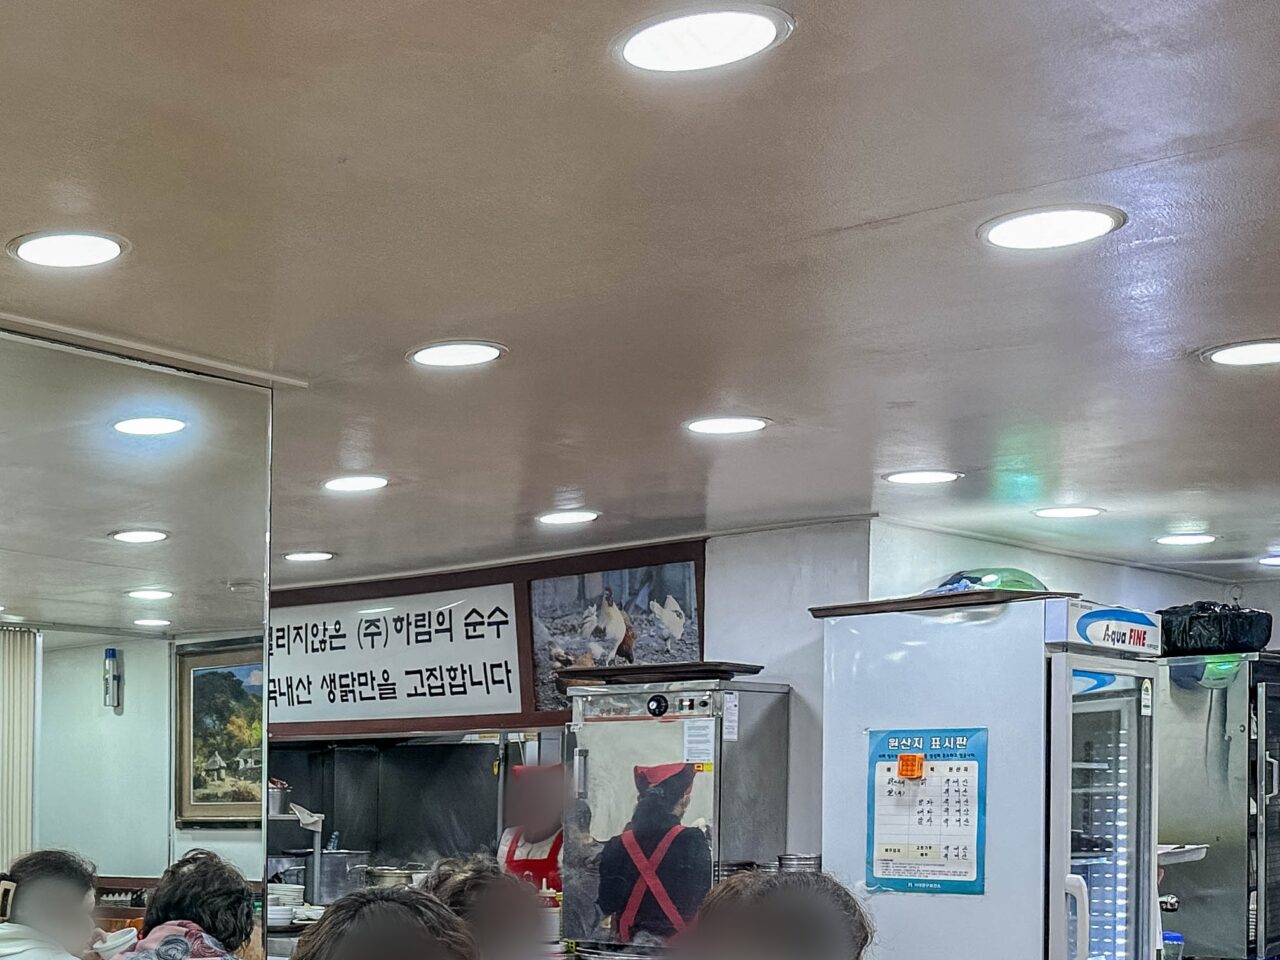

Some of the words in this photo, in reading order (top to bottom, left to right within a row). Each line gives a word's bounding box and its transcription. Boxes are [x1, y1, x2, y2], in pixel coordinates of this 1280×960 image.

[464, 606, 509, 640] 순수
[1103, 624, 1126, 646] Aqua
[1128, 628, 1147, 647] FINE
[321, 669, 397, 703] 생닭만을
[405, 660, 512, 697] 고집합니다
[888, 737, 923, 750] 원산지
[931, 736, 967, 749] 표시판
